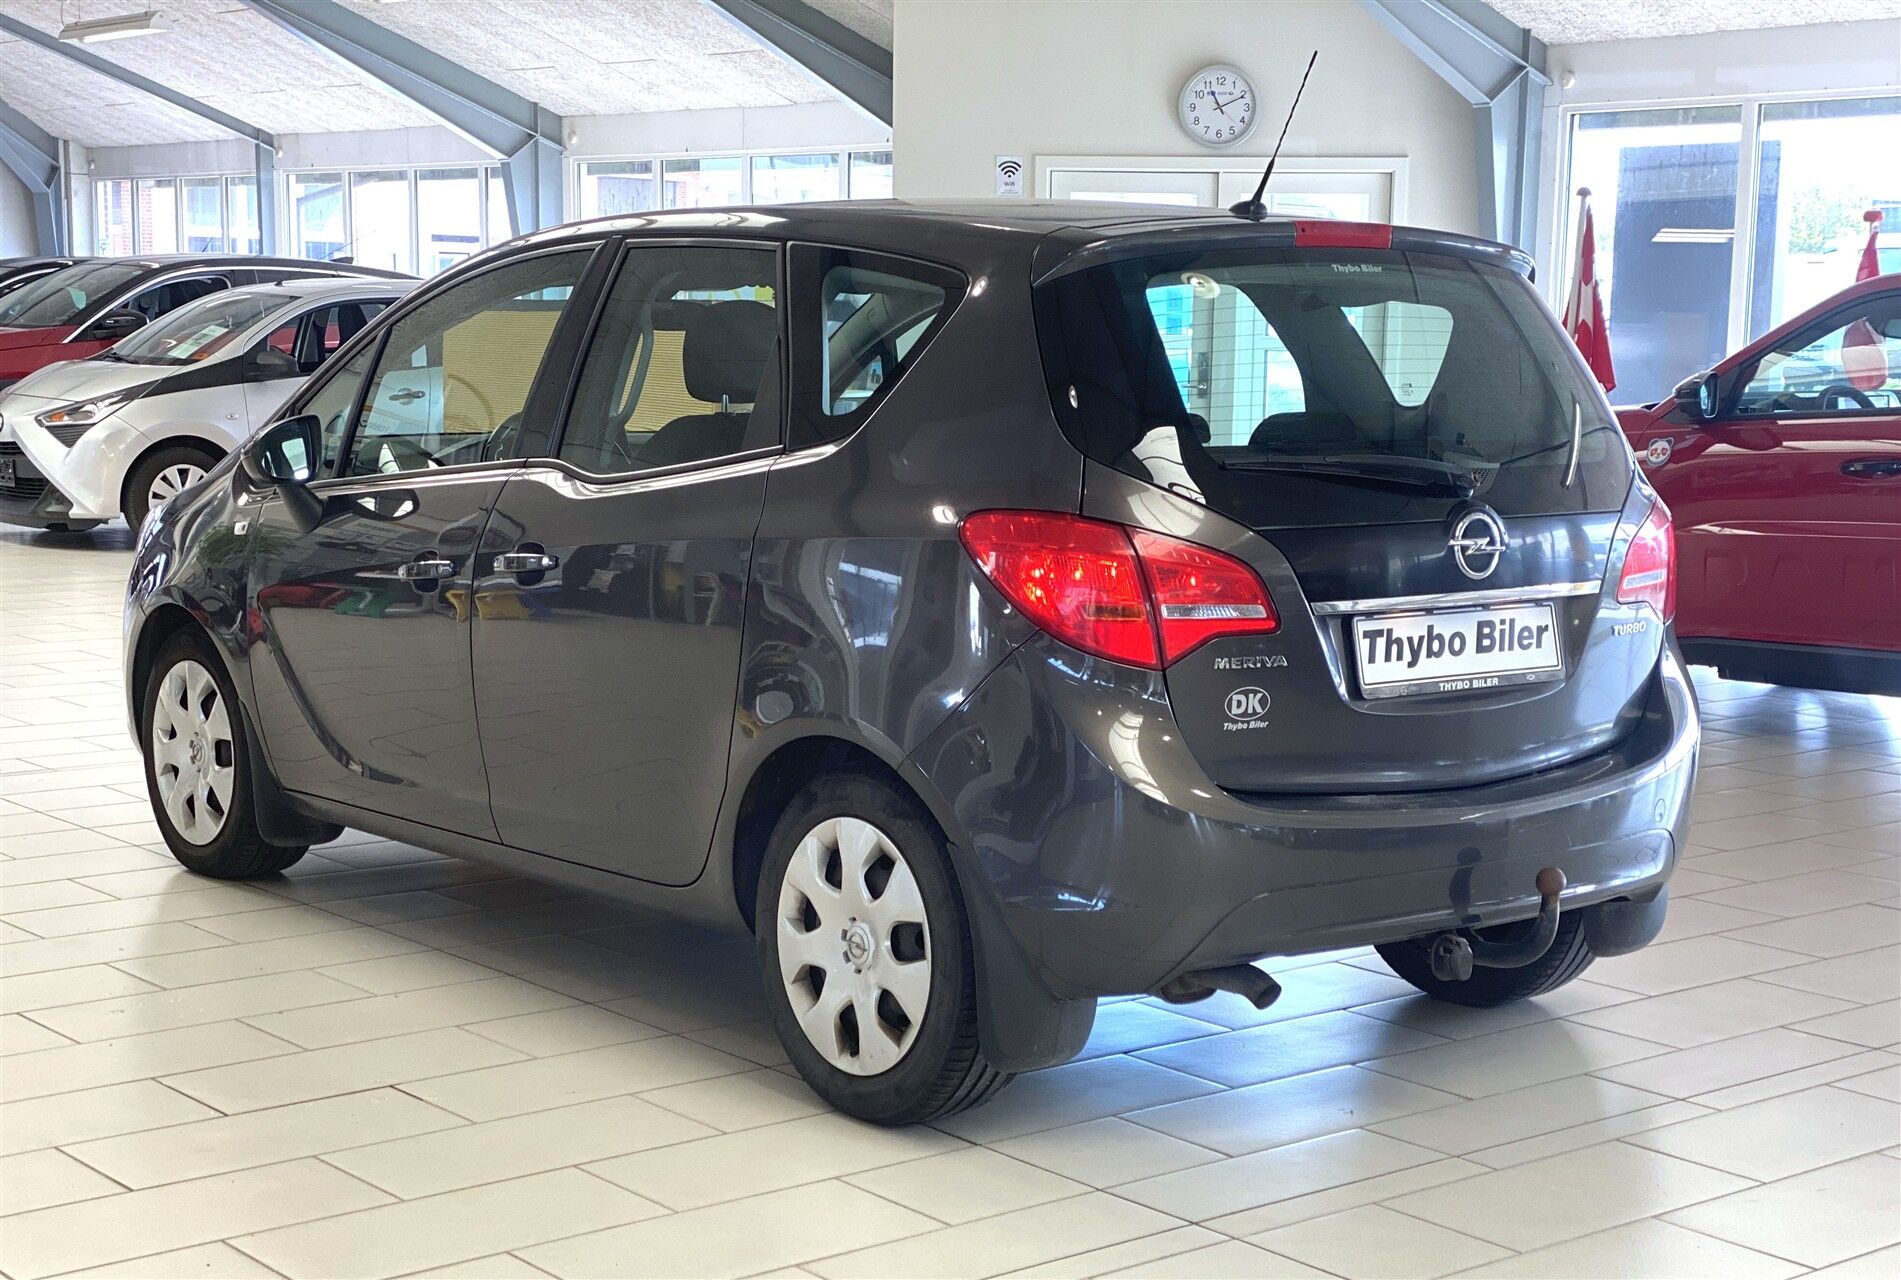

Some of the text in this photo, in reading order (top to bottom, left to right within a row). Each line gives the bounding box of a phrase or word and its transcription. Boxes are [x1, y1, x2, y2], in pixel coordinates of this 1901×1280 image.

[1204, 81, 1212, 89] 11
[1216, 76, 1226, 85] 12
[1232, 81, 1236, 89] 1
[1194, 90, 1204, 99] 10
[1190, 103, 1196, 112] 9
[1244, 103, 1250, 112] 3
[1194, 117, 1199, 125] 8
[1204, 126, 1209, 134] 7
[1216, 130, 1222, 138] 6
[1229, 126, 1235, 135] 5
[1331, 264, 1383, 273] Thybo Biler
[1611, 620, 1647, 636] TURBO
[1362, 618, 1549, 669] Thybo Biler
[1214, 656, 1288, 669] MERIVA
[1439, 678, 1498, 691] THYBO BILER
[1232, 693, 1264, 714] DK
[1223, 722, 1248, 731] Thybo
